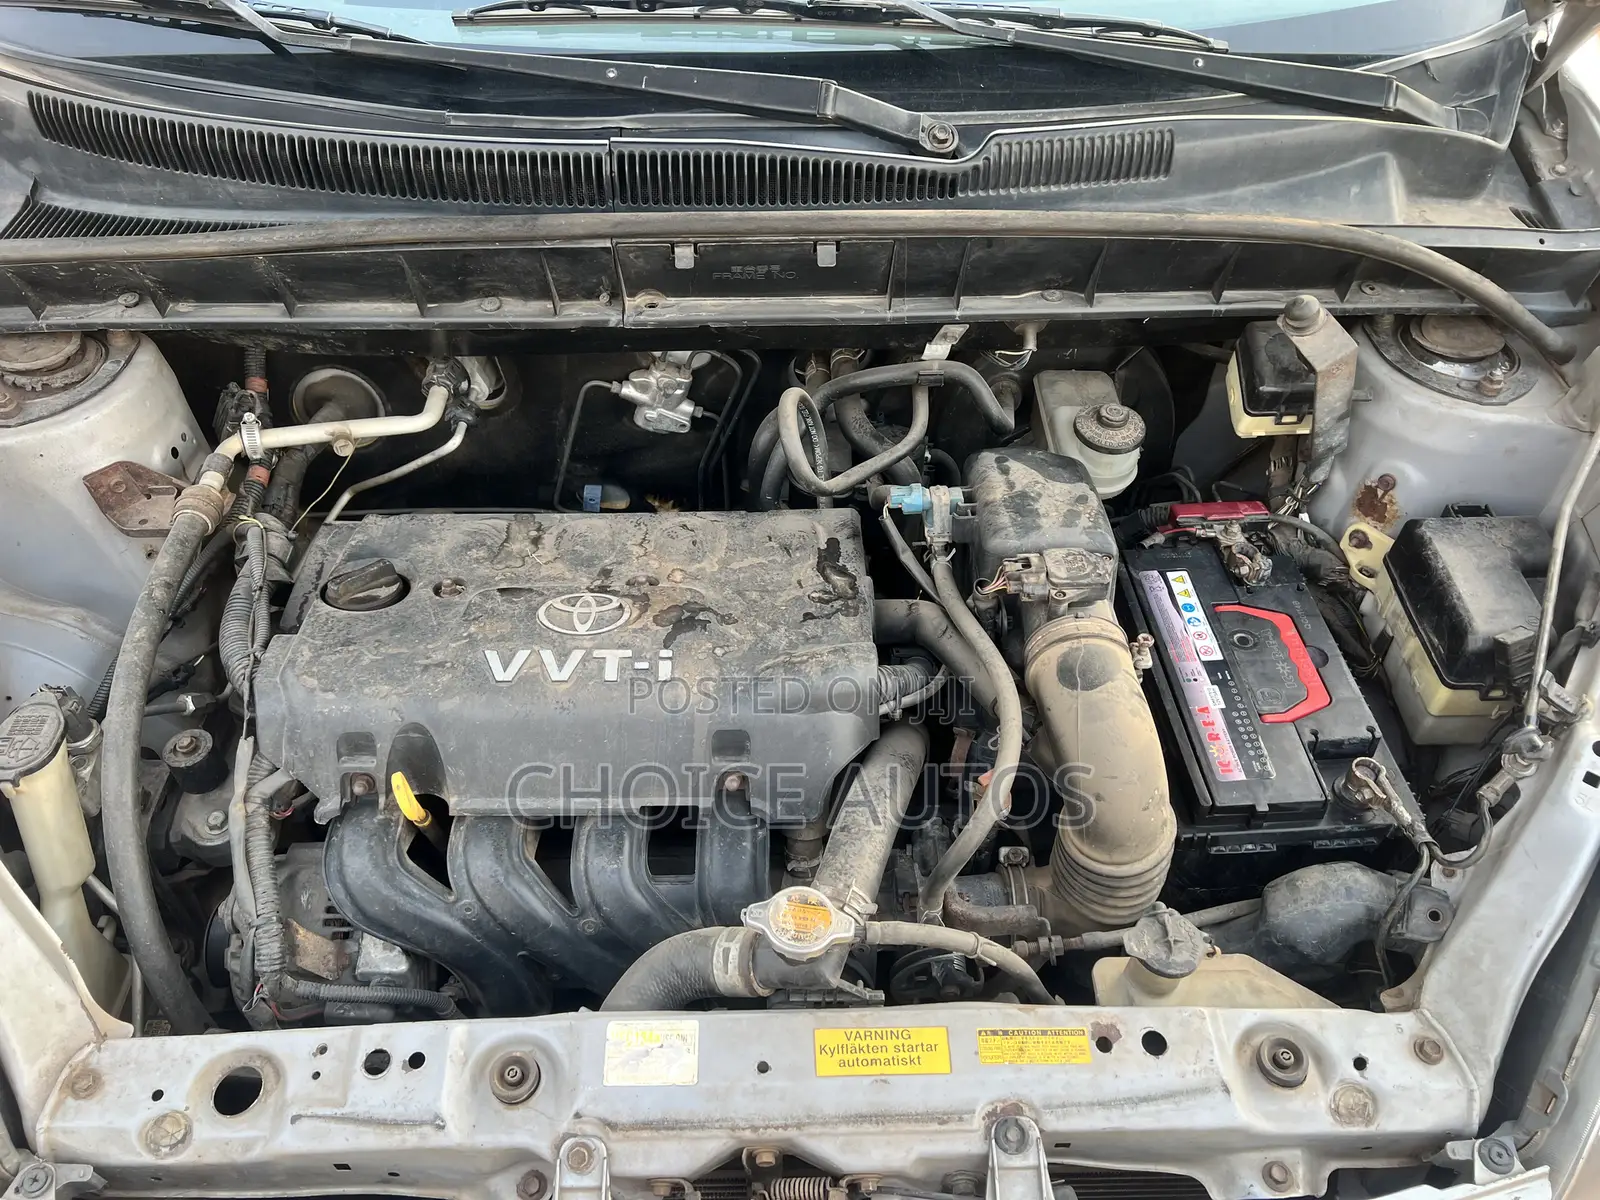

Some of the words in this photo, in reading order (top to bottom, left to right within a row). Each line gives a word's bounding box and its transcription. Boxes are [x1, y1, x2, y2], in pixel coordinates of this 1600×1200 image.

[712, 272, 766, 280] FRAME
[773, 271, 800, 280] NO.
[484, 649, 674, 682] VVT-i
[844, 1029, 912, 1041] VARNING
[819, 1043, 888, 1057] Kylfläkten
[893, 1042, 939, 1053] startar
[838, 1055, 922, 1068] automatiskt
